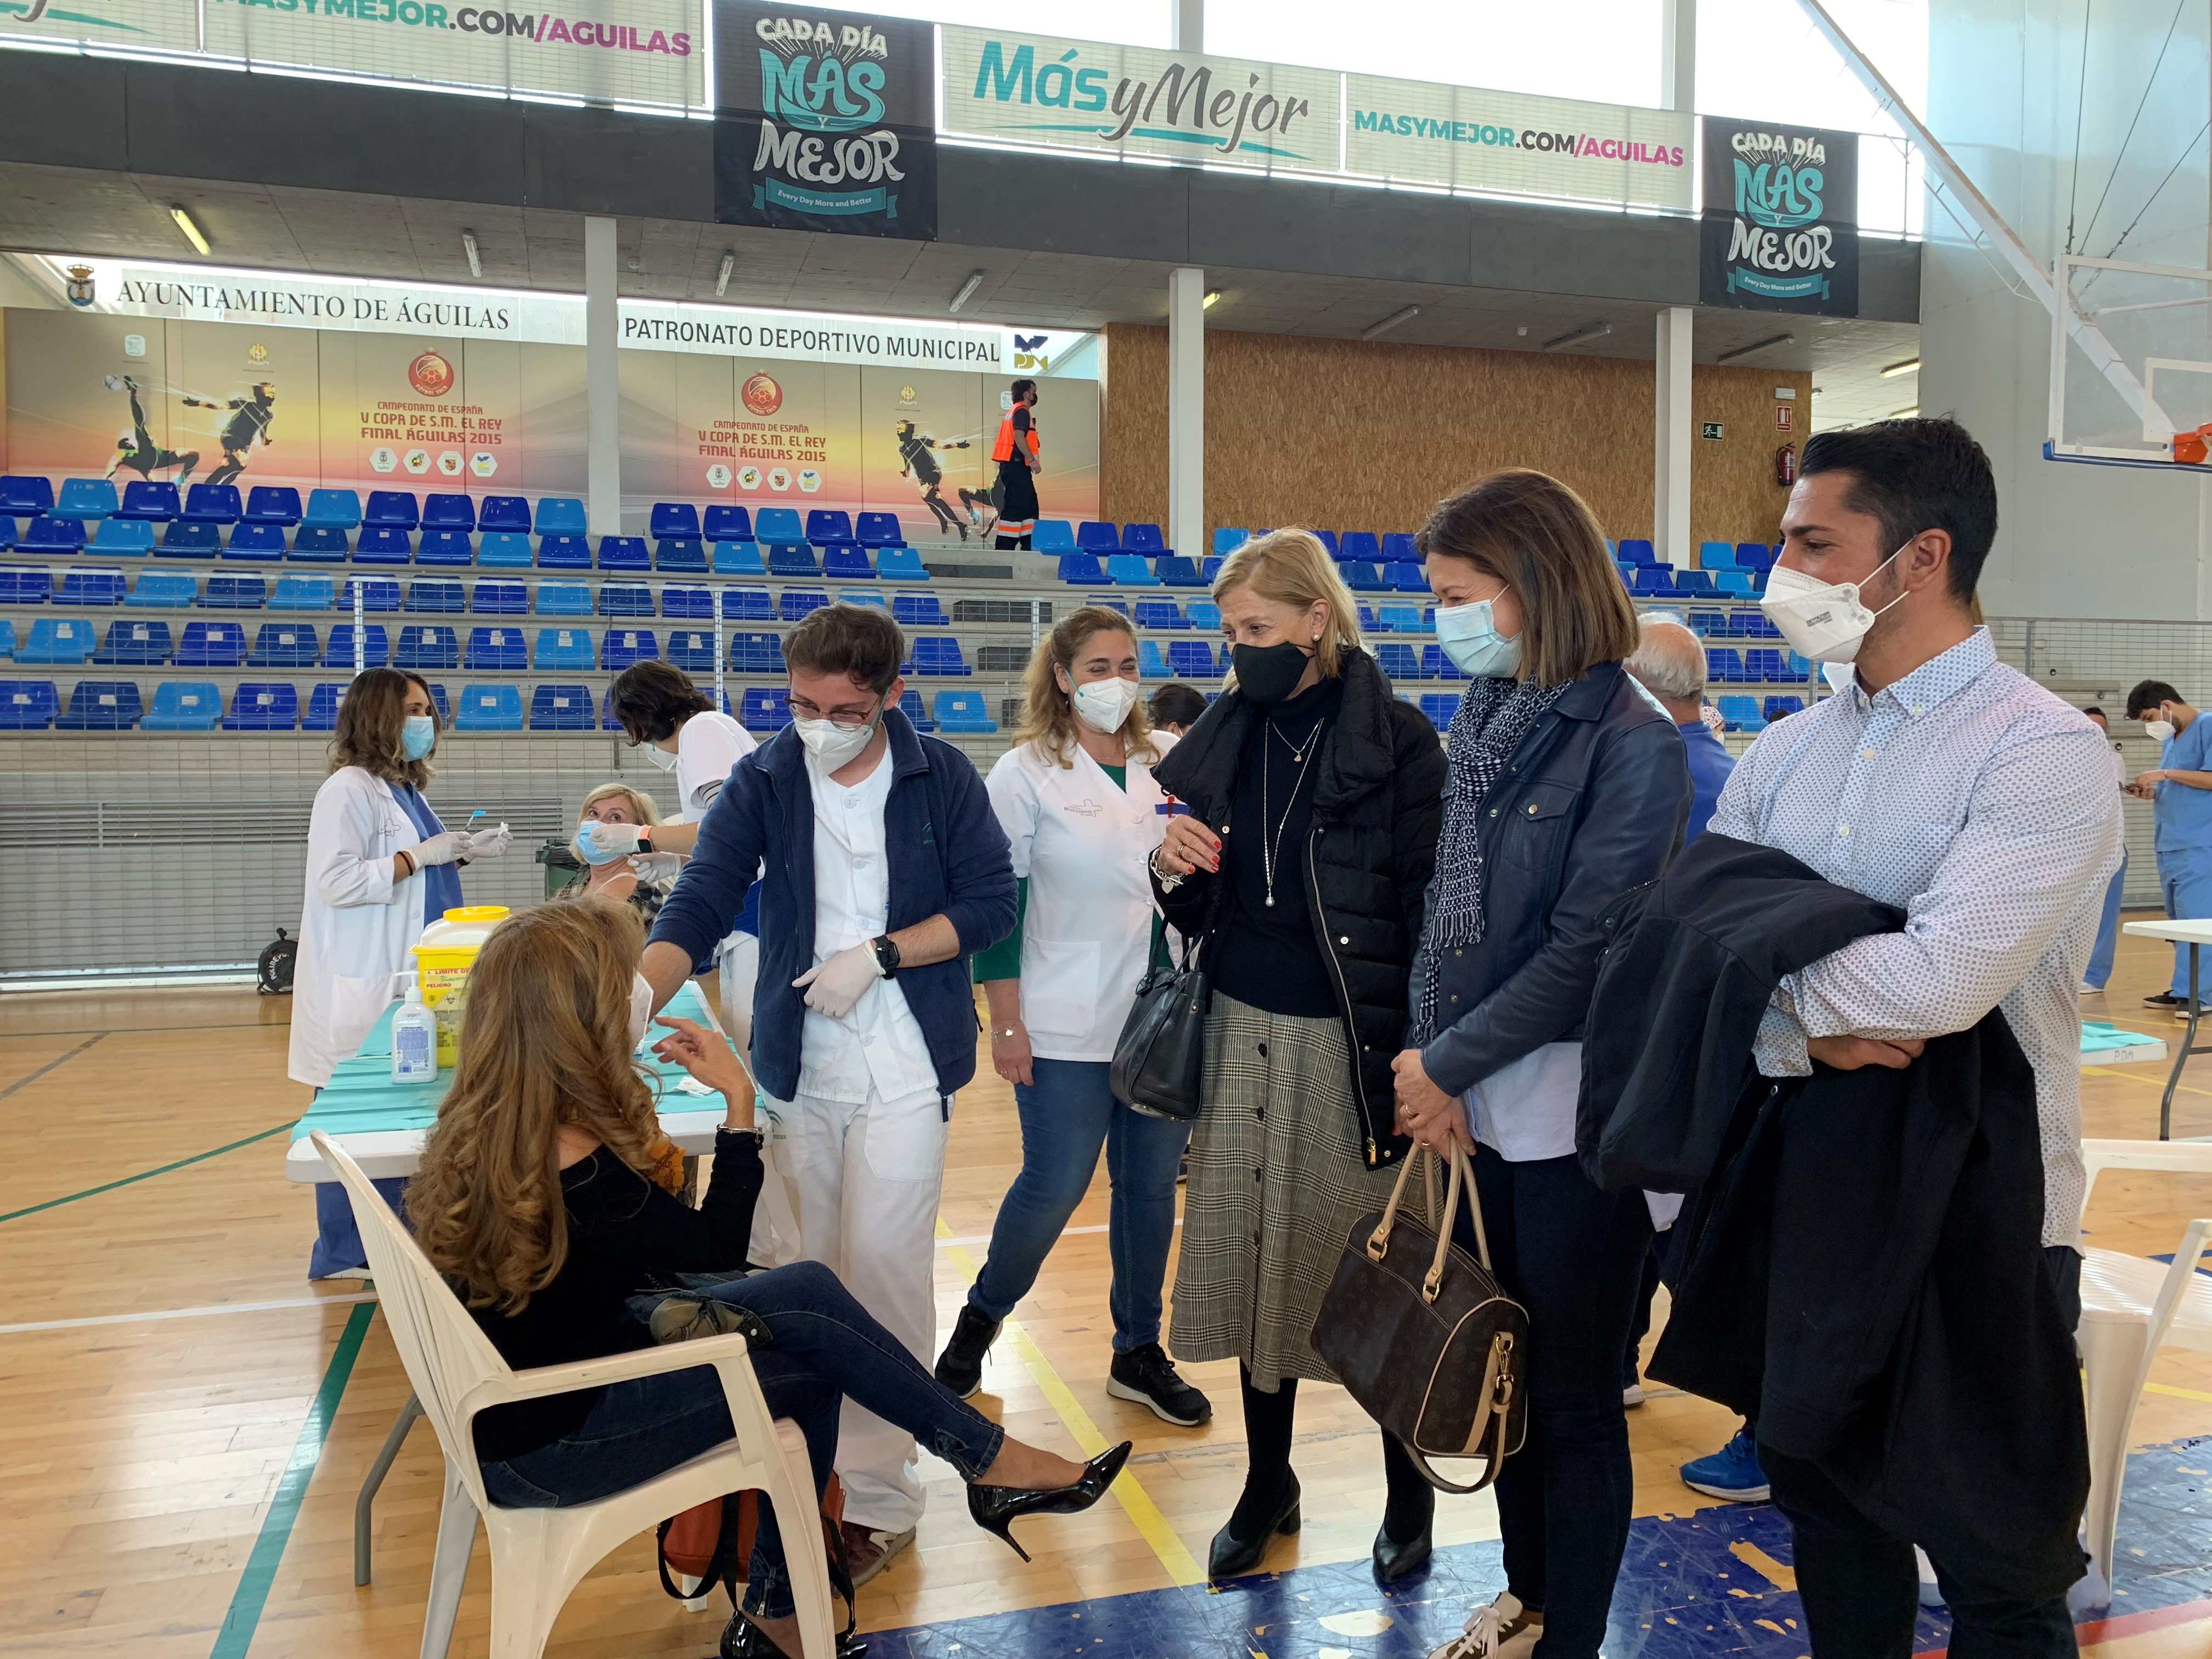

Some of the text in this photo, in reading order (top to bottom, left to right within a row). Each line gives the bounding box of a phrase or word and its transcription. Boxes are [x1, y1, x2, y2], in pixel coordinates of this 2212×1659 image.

[227, 0, 691, 57] YMEJOR.COM/AGUILAS
[755, 18, 888, 56] CADA DÍA
[759, 48, 886, 131] MÁS
[817, 117, 828, 129] Y
[1355, 110, 1684, 167] MASYMEJOR.COM/AGUILAS
[1731, 132, 1825, 163] CADA DÍA
[752, 118, 906, 184] MEJOR
[777, 189, 872, 207] Every Day More and Better
[1733, 157, 1824, 227] MÁS
[1774, 215, 1782, 225] Y
[1726, 217, 1836, 272] MEJOR
[1744, 276, 1759, 287] Every
[1759, 281, 1770, 290] Day
[1796, 281, 1813, 290] Better
[116, 280, 509, 330] AYUNTAMIENTO DE ÁGUILAS
[625, 318, 1001, 363] PATRONATO DEPORTIVO MUNICIPAL
[377, 401, 435, 412] CAMPEONATO
[452, 405, 483, 415] ESPAÑA
[374, 413, 406, 425] COPA
[409, 415, 426, 426] DE
[430, 416, 457, 428] S.M.
[461, 417, 475, 429] EL
[478, 419, 502, 430] REY
[714, 420, 766, 431] CAMPEONATO
[780, 424, 809, 433] ESPAÑA
[361, 427, 501, 444] FINAL ÁGUILAS 2015
[710, 431, 740, 443] COPA
[743, 433, 758, 444] DE
[761, 435, 786, 446] S.M.
[789, 436, 802, 447] EL
[805, 437, 826, 448] REY
[698, 445, 826, 462] FINAL ÁGUILAS 2015
[2114, 1050, 2134, 1062] PDM
